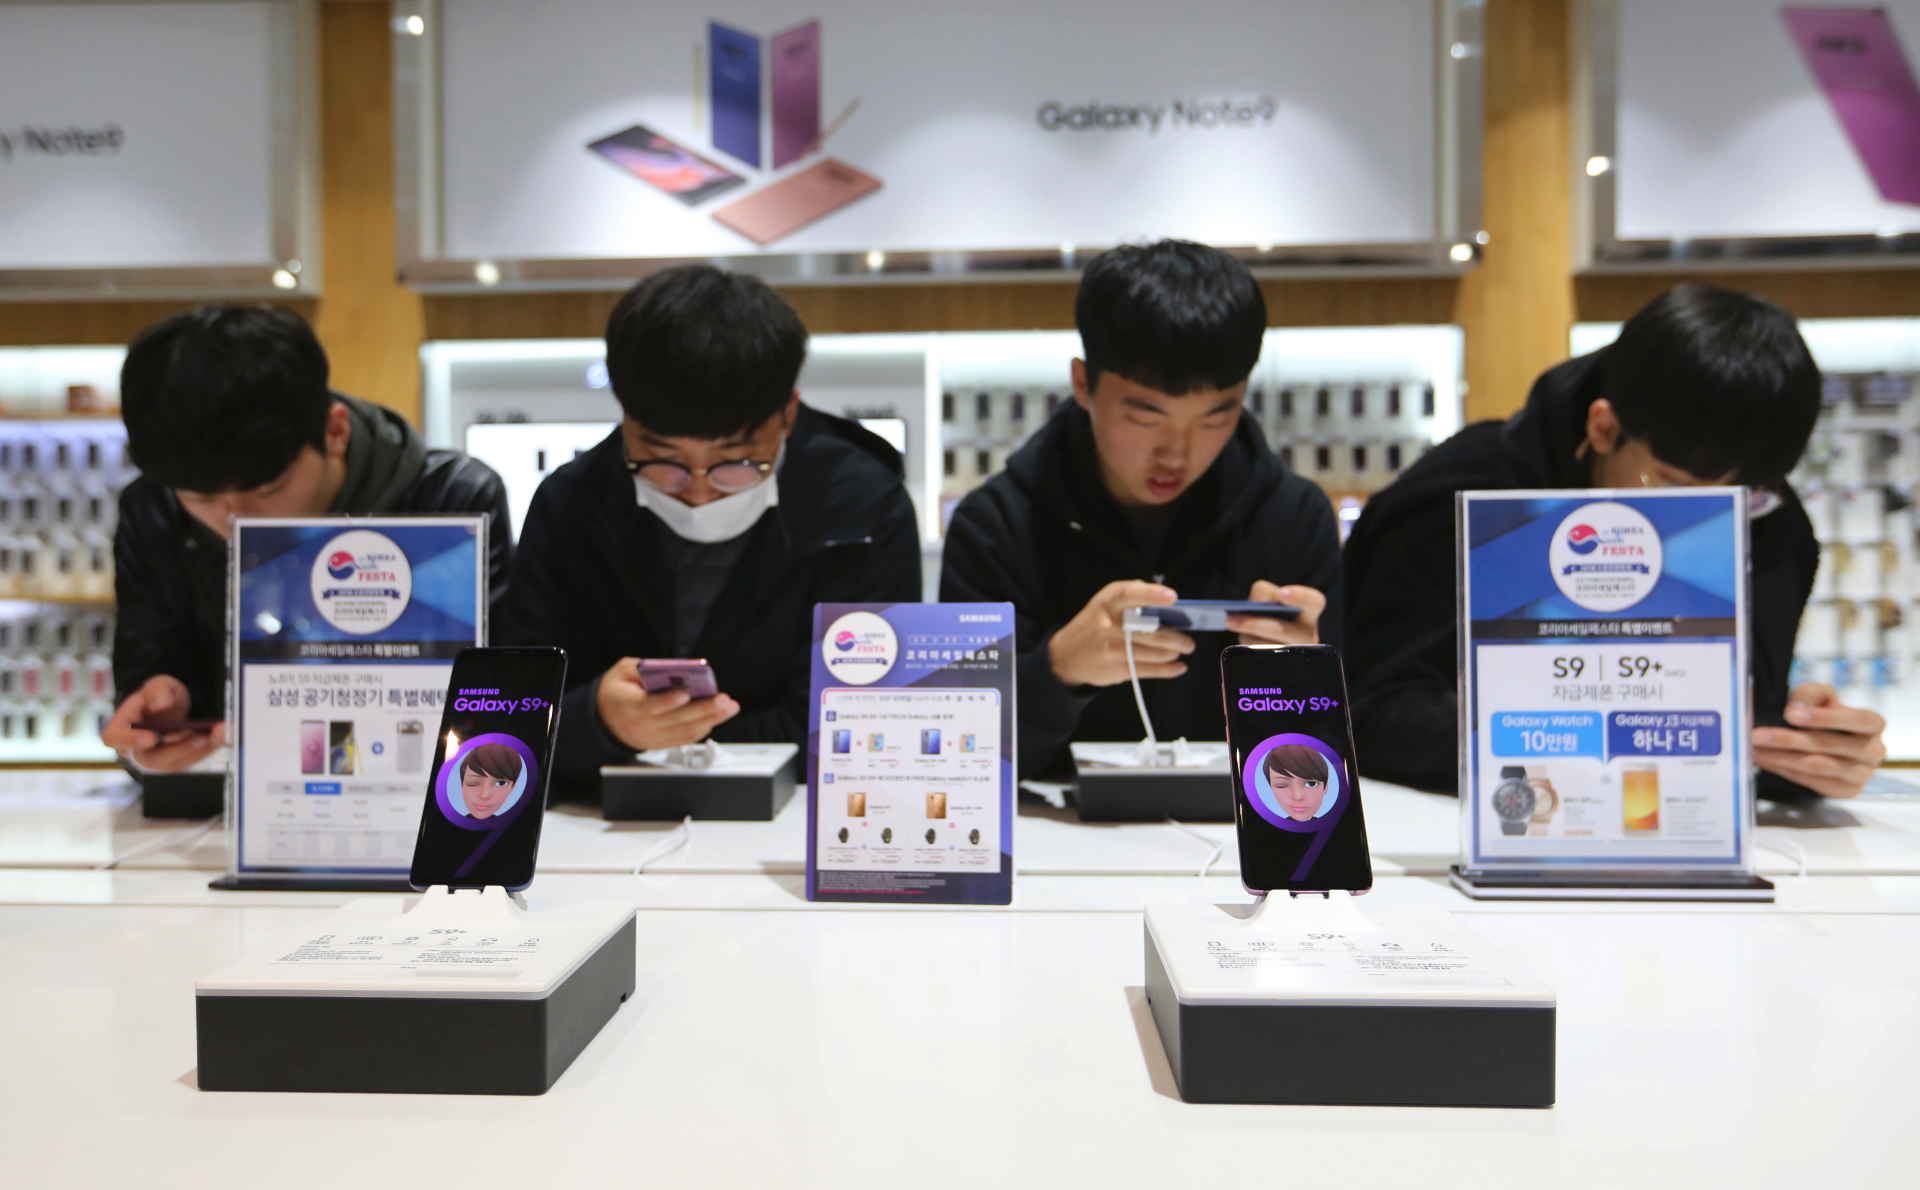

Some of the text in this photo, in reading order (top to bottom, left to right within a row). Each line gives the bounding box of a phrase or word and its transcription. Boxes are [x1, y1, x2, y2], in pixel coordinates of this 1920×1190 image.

[1038, 96, 1279, 137] Galaxy Note9
[22, 122, 125, 156] Note9
[1602, 546, 1645, 556] FESTA
[358, 572, 397, 582] FESTA
[958, 614, 1002, 623] SAMSUNG
[1538, 621, 1674, 636] 코리아세일페스타 특별이벤트
[857, 645, 886, 653] FESTA
[906, 649, 999, 661] 코리아세일페스타
[1553, 656, 1585, 679] S9
[1618, 655, 1664, 679] S9+
[354, 672, 383, 686] 구매시
[268, 688, 299, 707] 삼성
[303, 688, 383, 708] 공기청정기
[458, 688, 500, 696] SAMSUNG
[1238, 687, 1282, 695] SAMSUNG
[1552, 683, 1664, 702] 자급제폰 구매시
[454, 697, 550, 715] Galaxy S9+
[1238, 696, 1340, 715] Galaxy S9+
[1502, 714, 1593, 729] Galaxy Watch
[1615, 713, 1663, 730] Galaxy
[1520, 730, 1578, 752] 10만원
[1632, 728, 1699, 752] 하나 더
